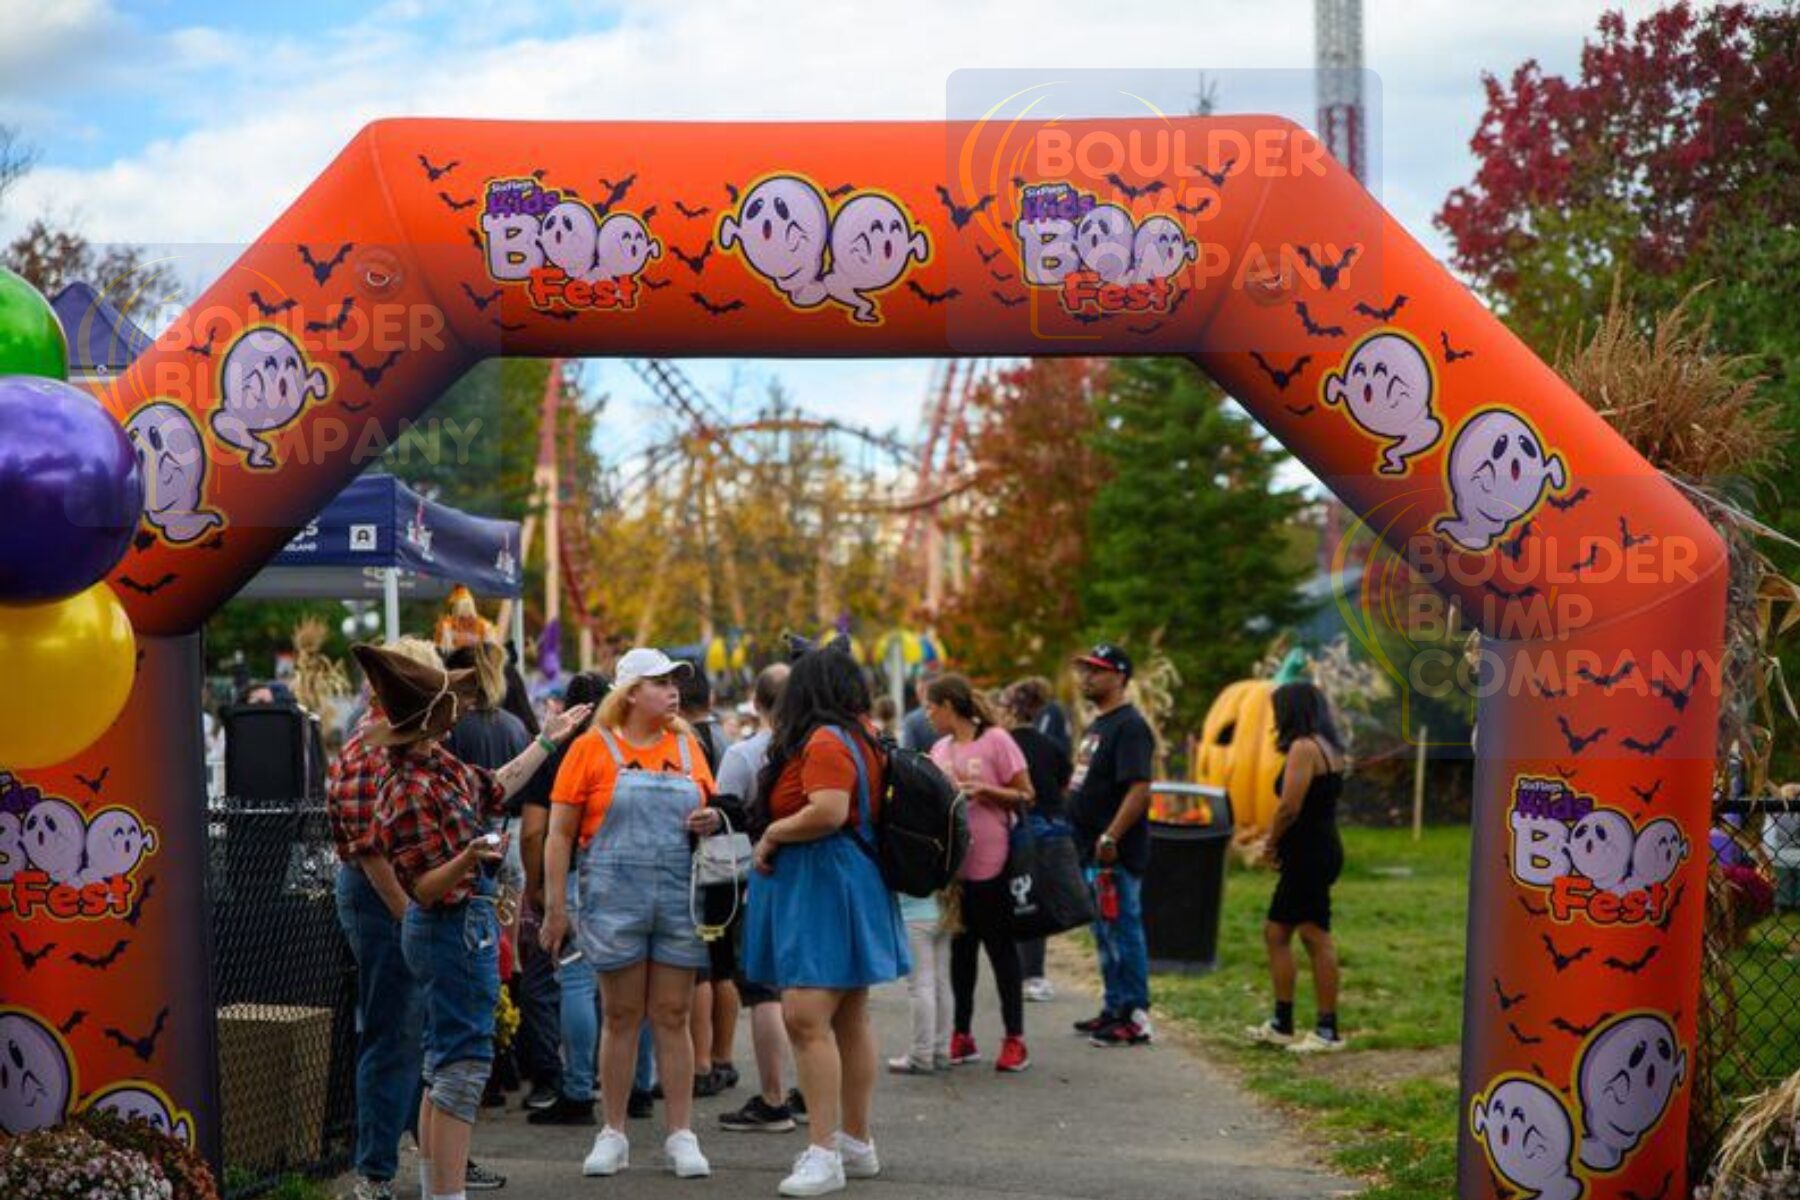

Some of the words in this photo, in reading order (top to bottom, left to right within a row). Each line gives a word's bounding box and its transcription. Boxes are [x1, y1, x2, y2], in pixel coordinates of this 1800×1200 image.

[530, 267, 637, 306] Fest
[1064, 271, 1173, 311] Fest
[13, 870, 130, 918] Fest
[1552, 876, 1665, 922] Fest
